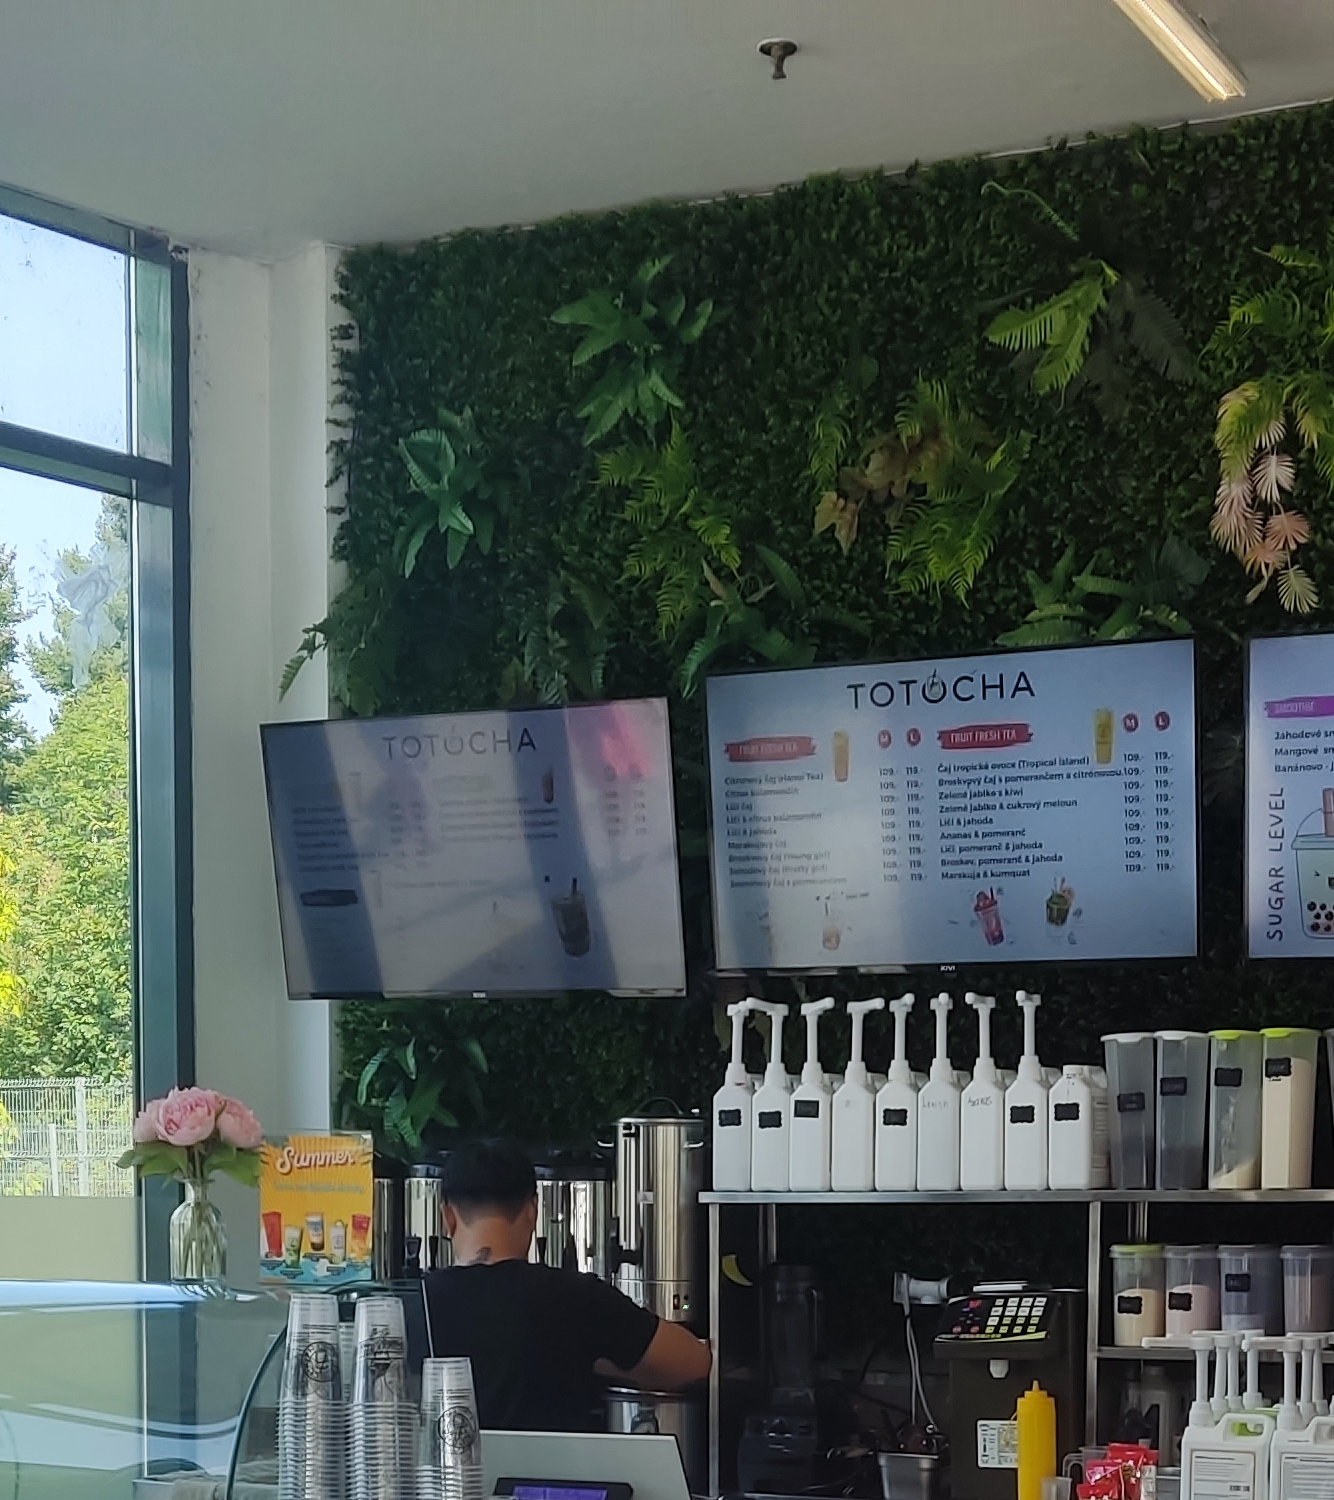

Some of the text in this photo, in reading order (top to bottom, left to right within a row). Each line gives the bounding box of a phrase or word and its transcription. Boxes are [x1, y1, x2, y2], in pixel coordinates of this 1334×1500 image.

[847, 669, 1035, 709] TOTOCHA
[382, 728, 536, 760] TOTOCHA
[963, 816, 993, 827] jahoda
[1267, 787, 1285, 941] SUGAR LEVEL
